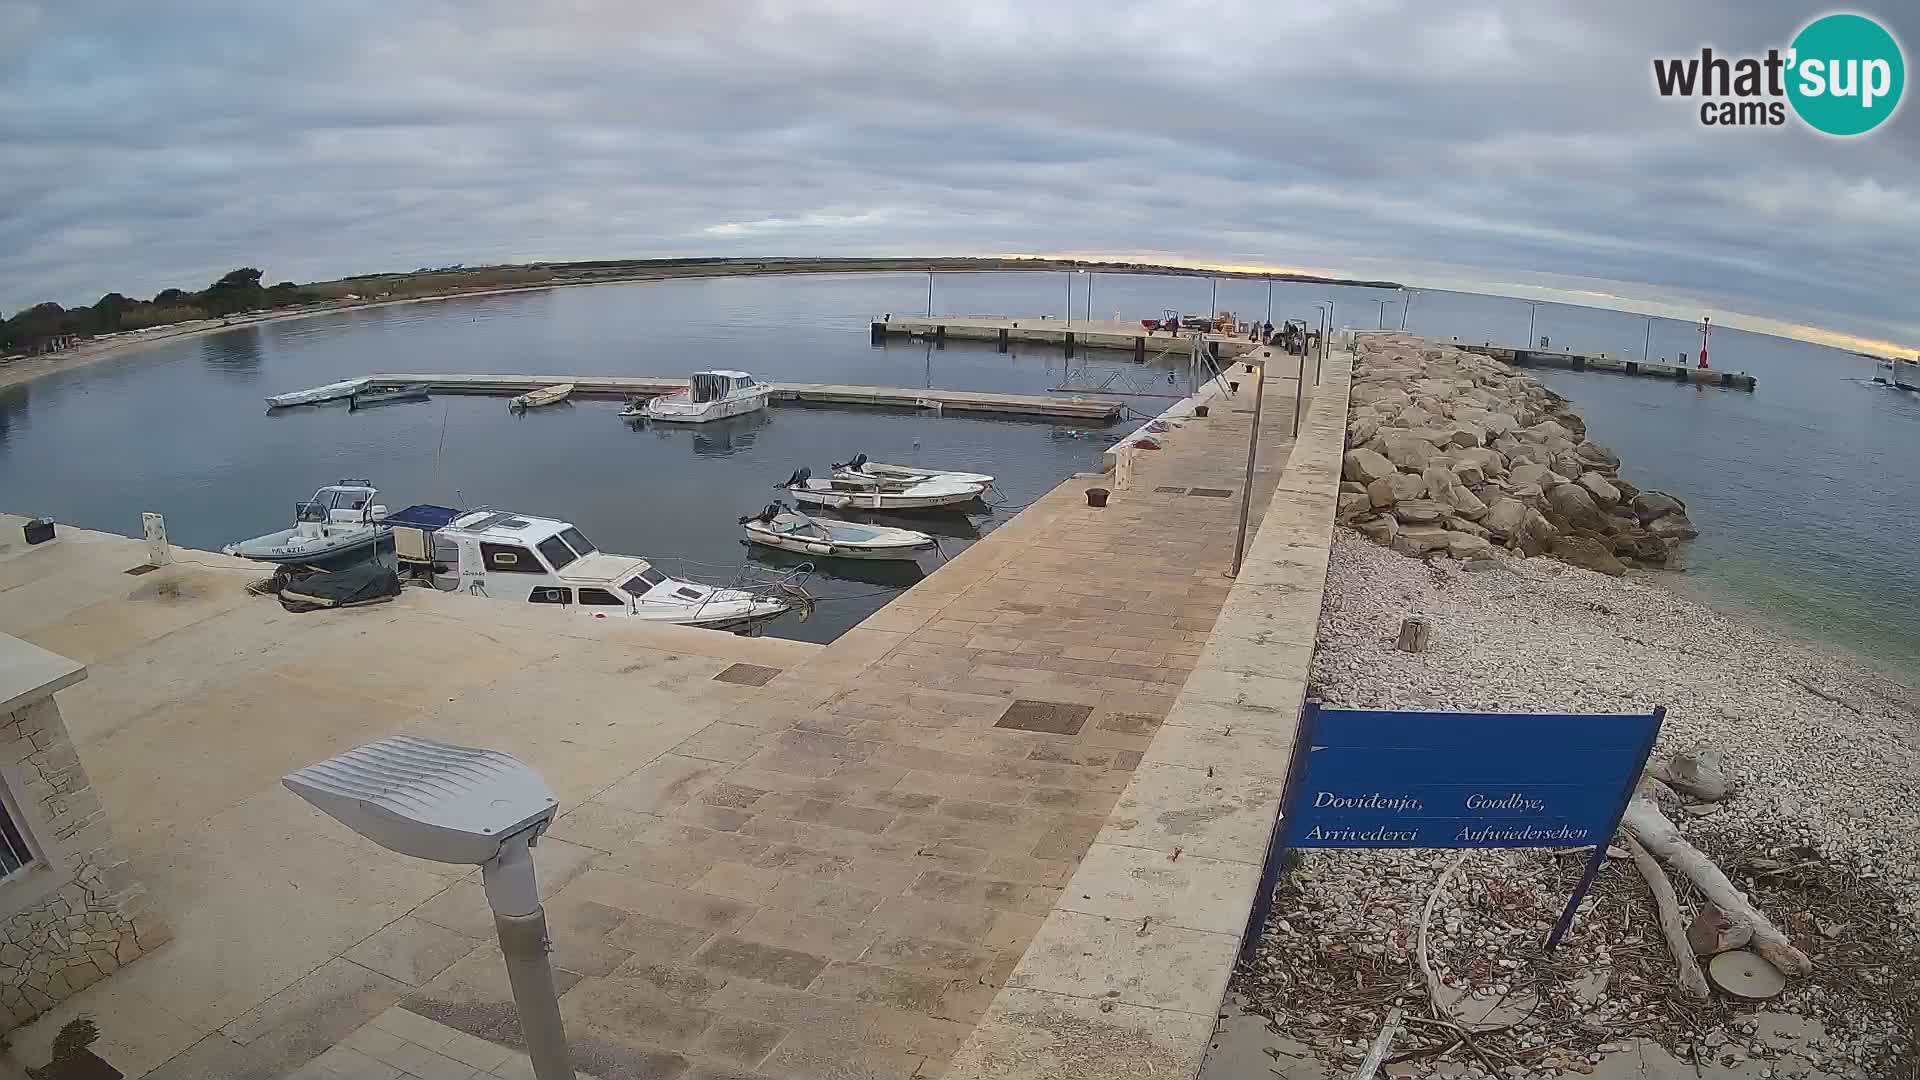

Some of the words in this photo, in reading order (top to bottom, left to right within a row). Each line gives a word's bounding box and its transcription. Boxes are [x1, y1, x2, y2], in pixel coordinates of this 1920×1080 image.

[1466, 793, 1545, 813] Goodbye,
[1304, 825, 1419, 841] Arrivederci
[1454, 824, 1589, 844] Aufwiedersehen
